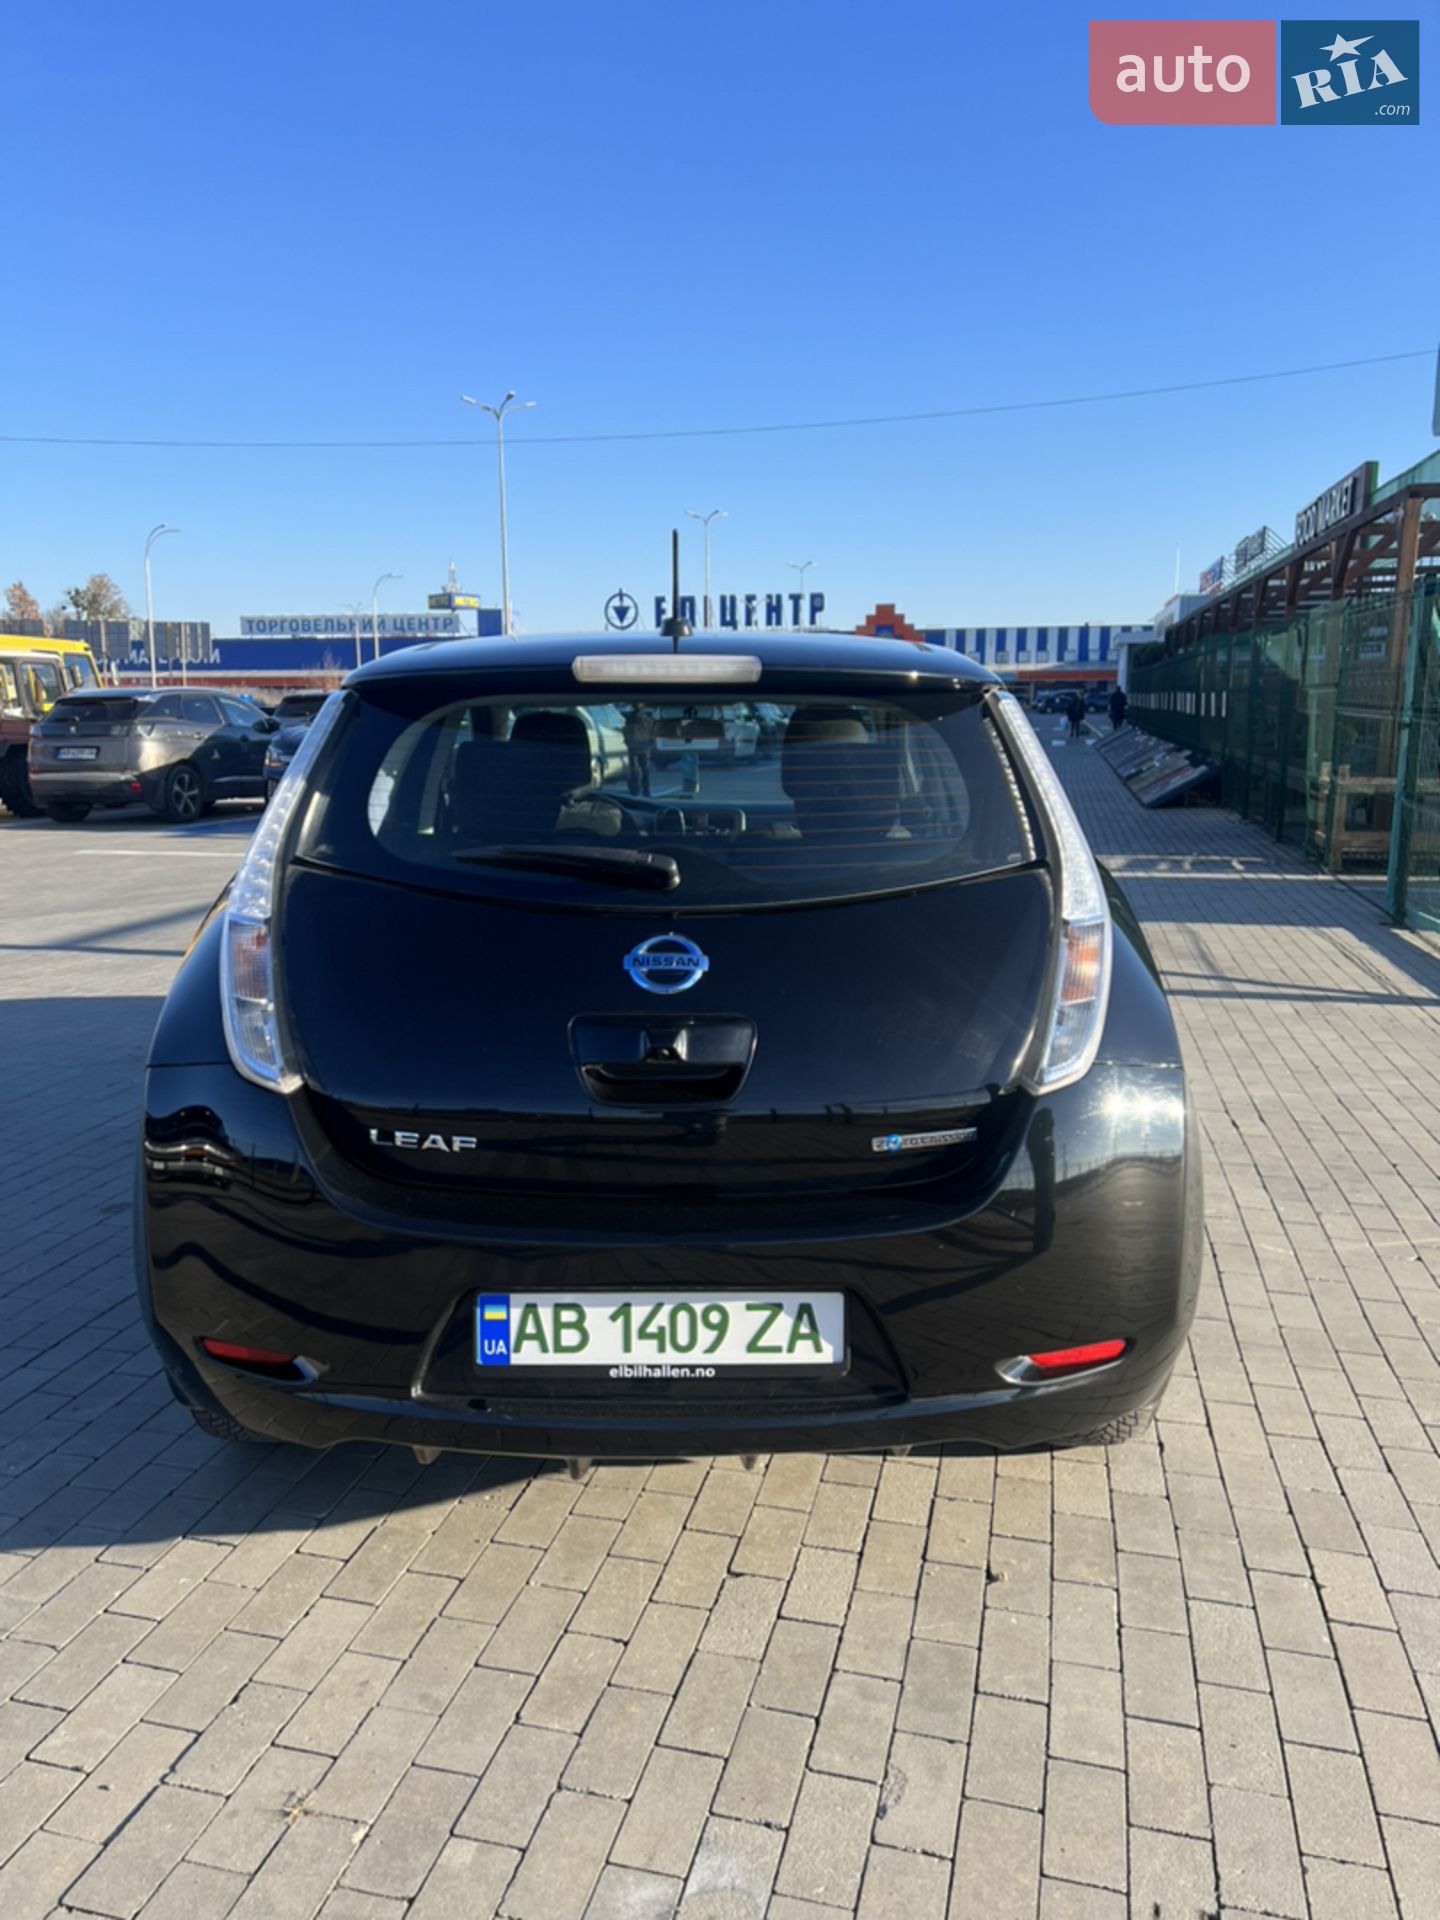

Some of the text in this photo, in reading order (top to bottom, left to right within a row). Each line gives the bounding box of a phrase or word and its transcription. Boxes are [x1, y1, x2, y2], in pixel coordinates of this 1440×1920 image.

[392, 616, 454, 634] ЦЕНТР
[632, 956, 700, 967] NISSAN
[369, 1128, 478, 1153] LEAF
[483, 1302, 823, 1355] UA AB 1409 ZA
[609, 1364, 716, 1379] elbilhallen.no
